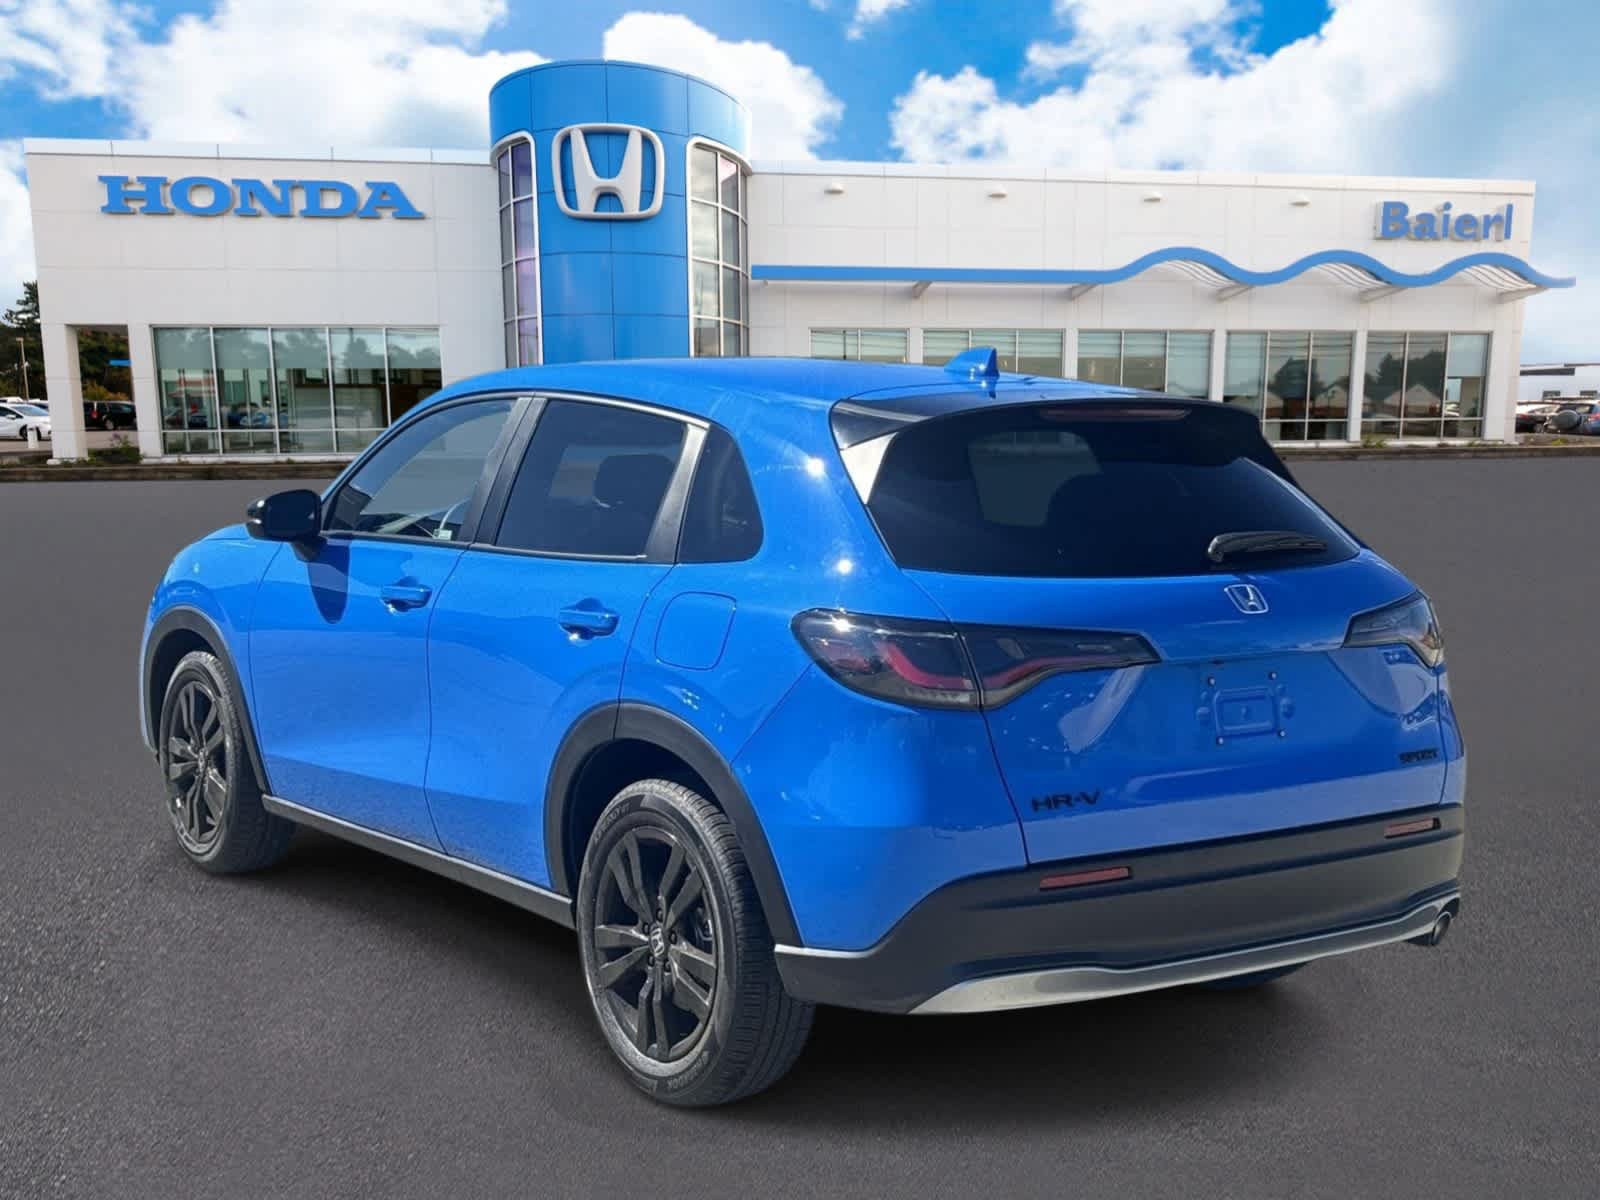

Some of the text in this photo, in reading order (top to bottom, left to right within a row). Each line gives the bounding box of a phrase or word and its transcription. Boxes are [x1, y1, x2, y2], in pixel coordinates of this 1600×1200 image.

[98, 175, 425, 219] HONDA
[1375, 201, 1514, 240] Baierl
[1031, 790, 1100, 812] HR-V
